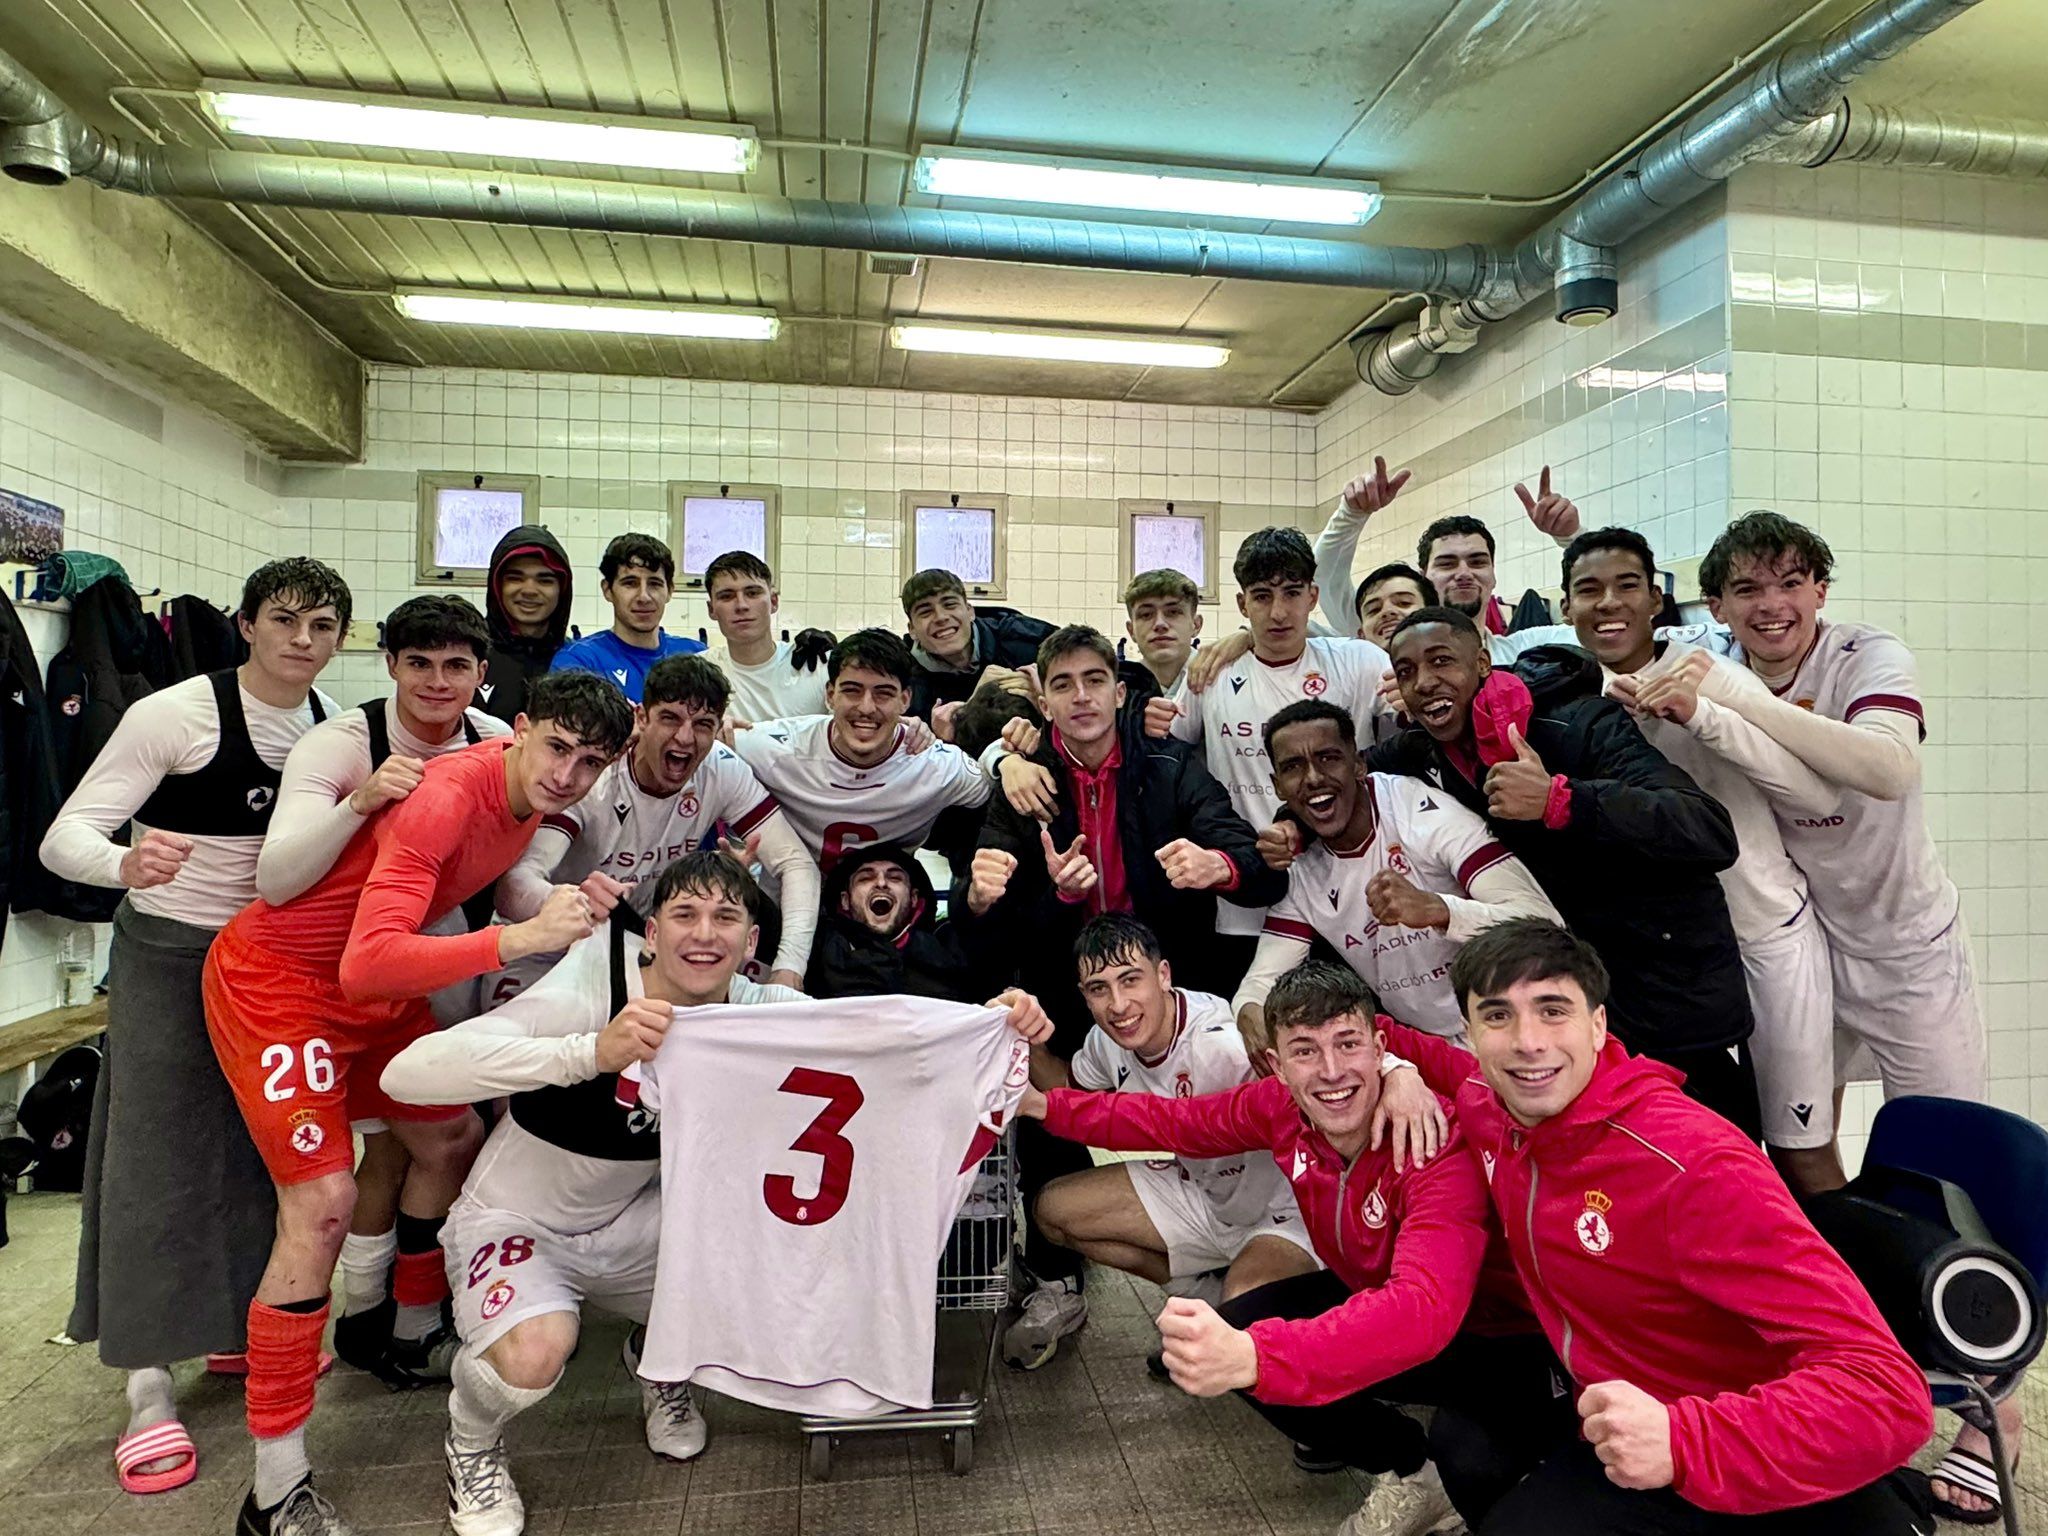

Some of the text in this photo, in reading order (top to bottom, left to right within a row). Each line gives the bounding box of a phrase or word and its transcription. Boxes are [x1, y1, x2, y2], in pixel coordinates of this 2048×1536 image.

[1794, 815, 1845, 828] RMD
[600, 839, 699, 868] ASPIRE
[261, 1037, 335, 1103] 26
[763, 1066, 865, 1226] 3
[467, 1234, 536, 1290] 28
